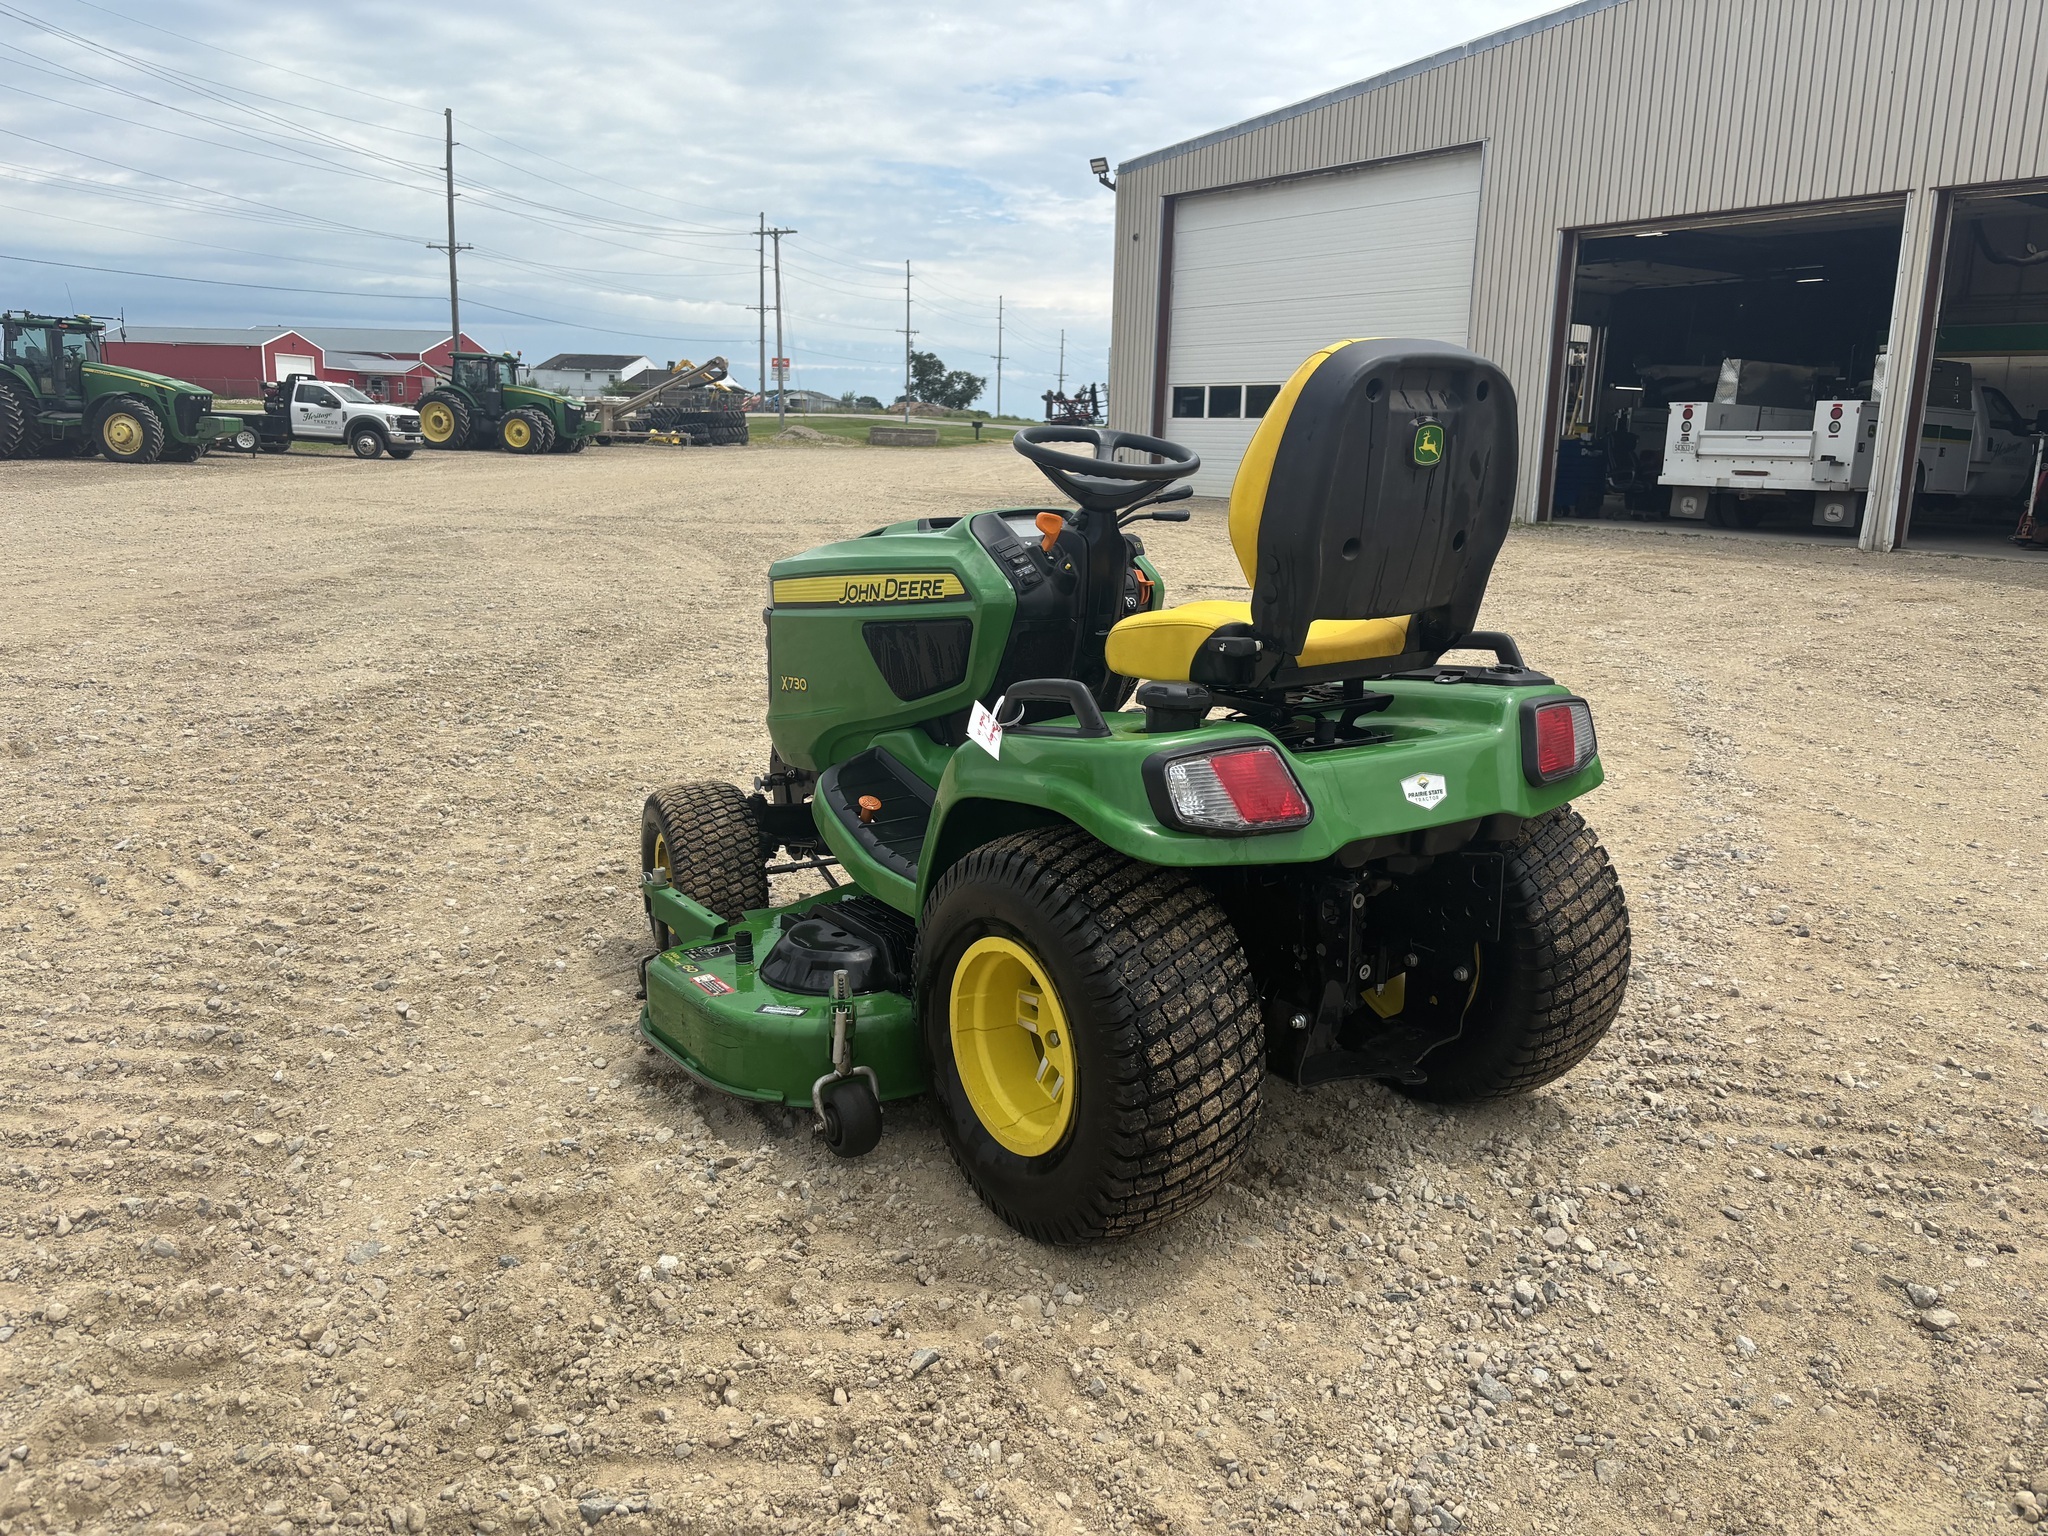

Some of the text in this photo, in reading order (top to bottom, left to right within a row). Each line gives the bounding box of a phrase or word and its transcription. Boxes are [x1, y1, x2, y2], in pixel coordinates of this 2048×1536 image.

[302, 412, 332, 421] Heritage
[839, 578, 945, 602] JOHN DEERE
[781, 675, 807, 691] X730
